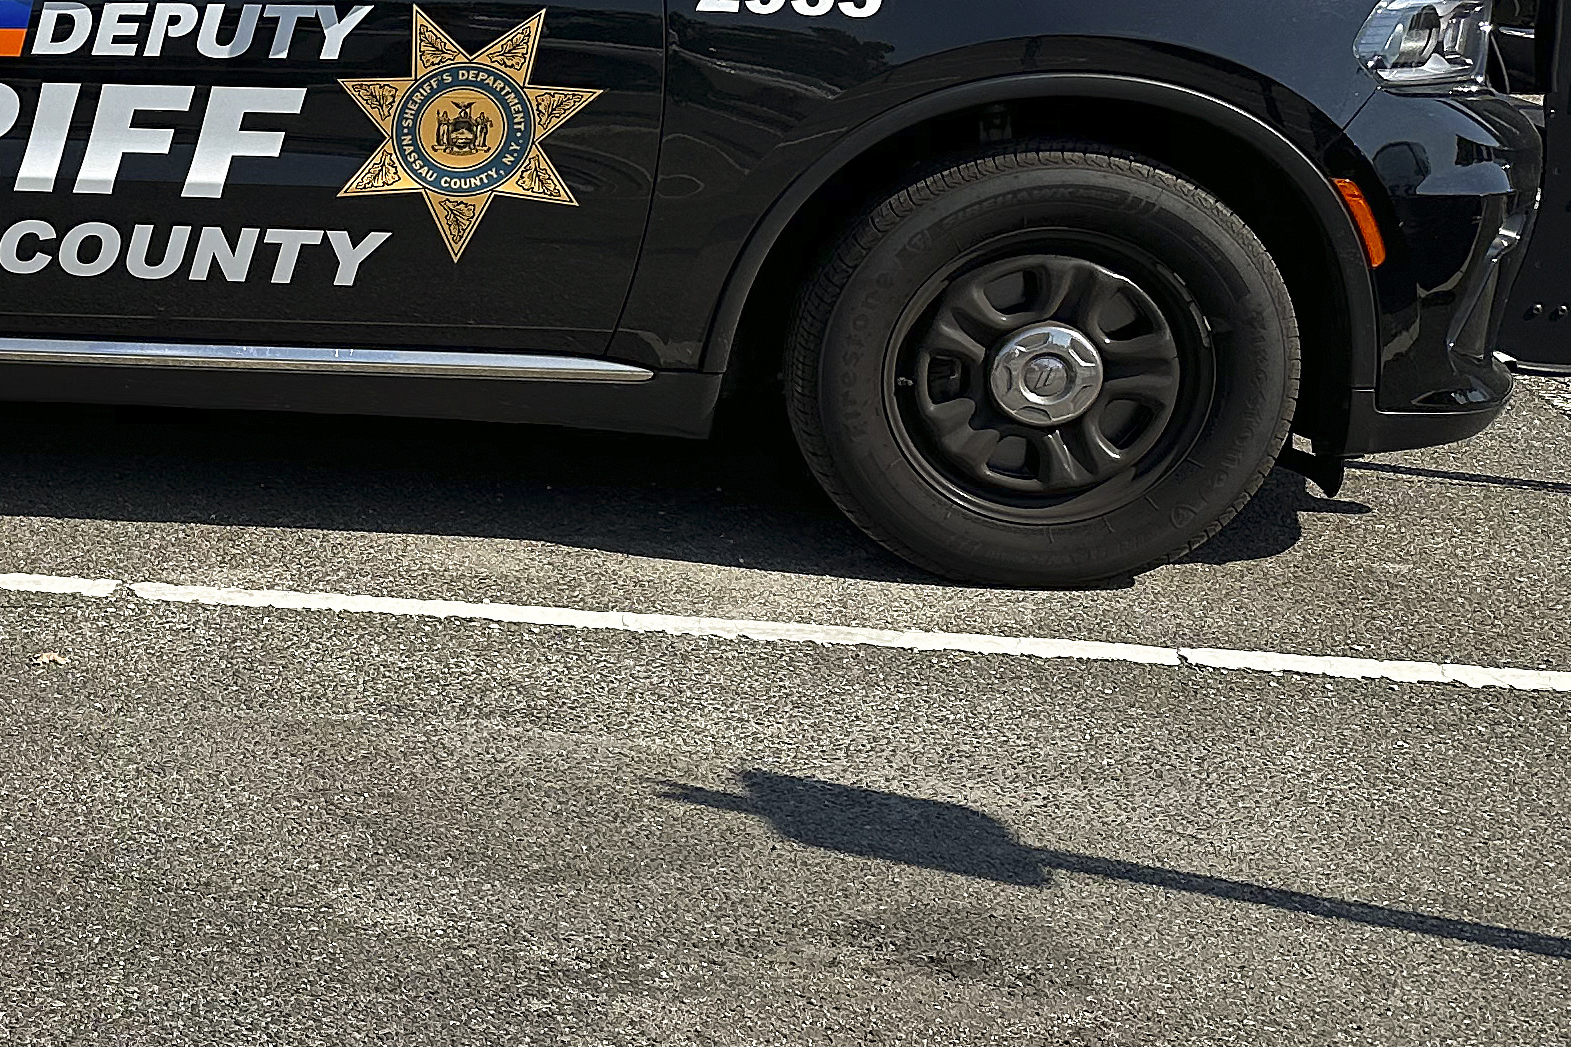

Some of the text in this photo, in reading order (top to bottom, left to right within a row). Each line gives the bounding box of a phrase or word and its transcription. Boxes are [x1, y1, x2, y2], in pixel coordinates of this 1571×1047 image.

[30, 1, 375, 60] DEPUTY
[402, 69, 525, 132] SHERIFF'S DEPARTMENT
[401, 134, 436, 183] NASSAU
[440, 167, 506, 190] COUNTY,
